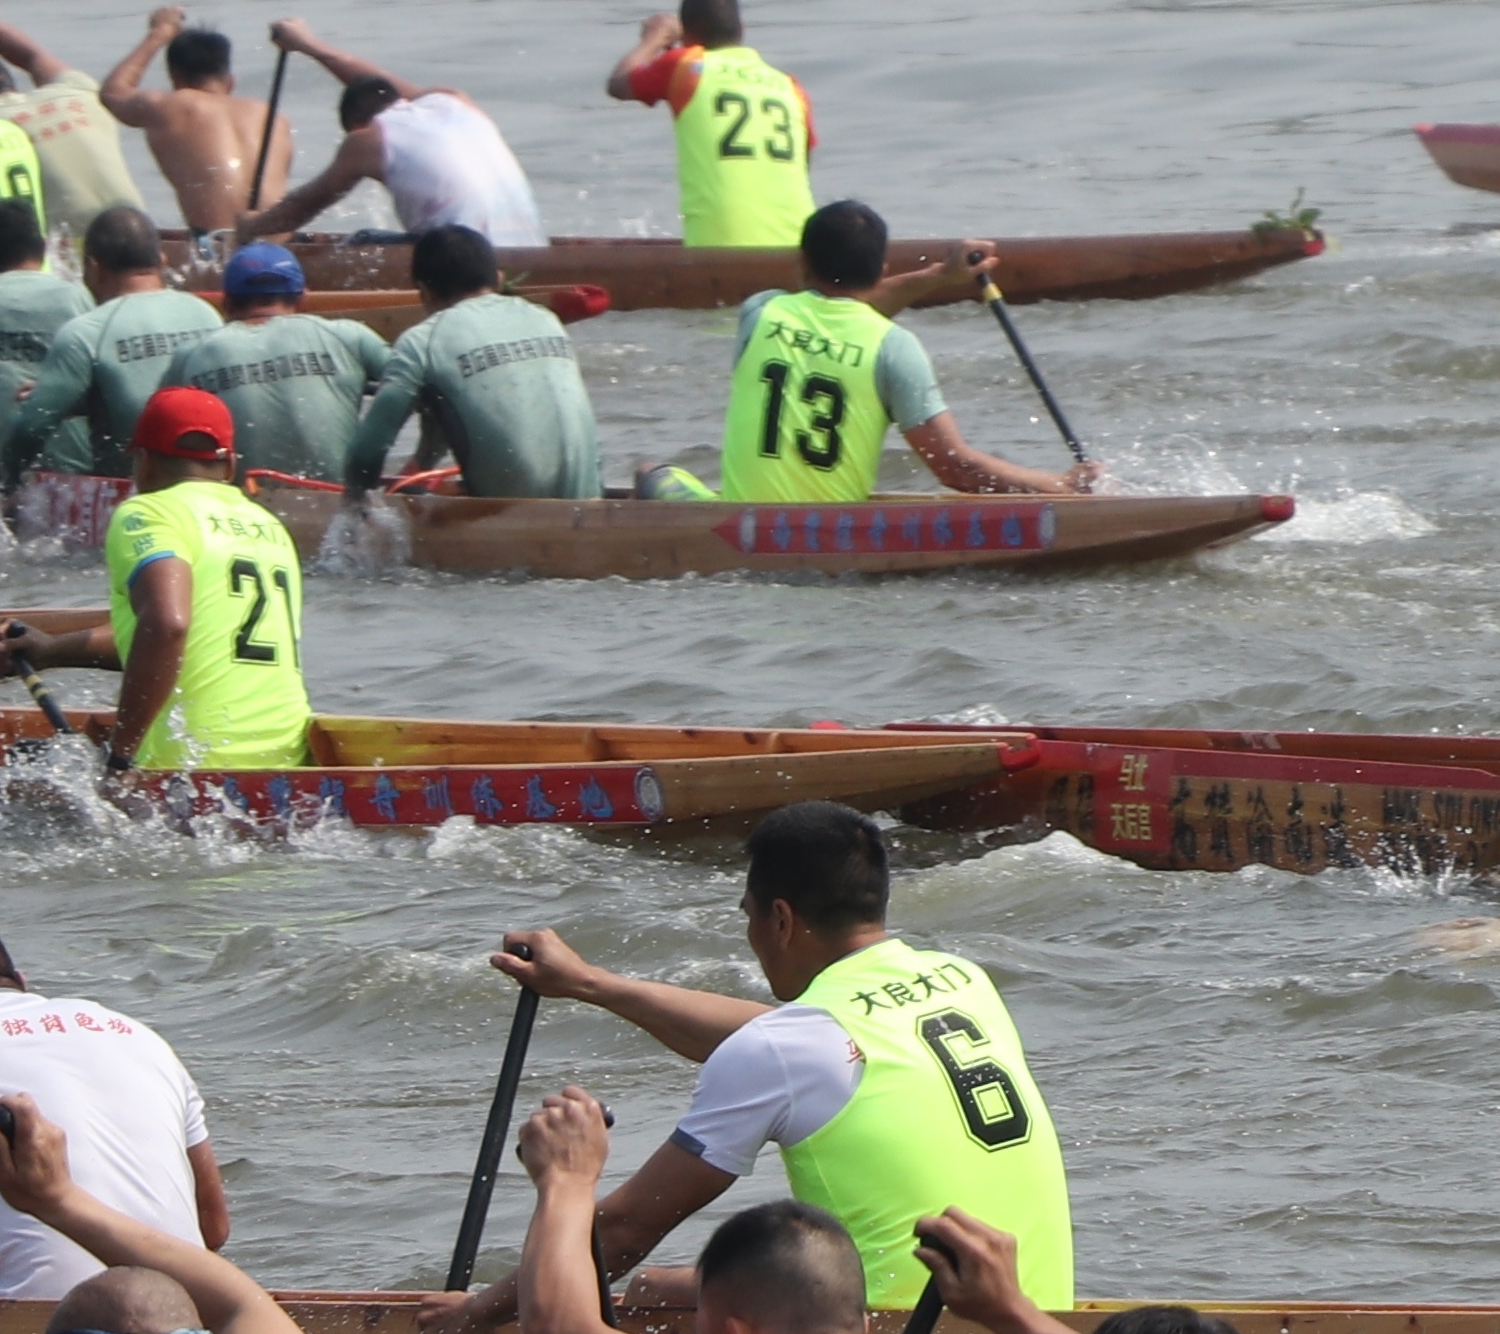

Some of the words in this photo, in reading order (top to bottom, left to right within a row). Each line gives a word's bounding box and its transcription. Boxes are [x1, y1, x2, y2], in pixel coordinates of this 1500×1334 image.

[714, 86, 795, 163] 23
[767, 319, 863, 368] 大良大门
[758, 357, 848, 473] 13
[208, 513, 290, 547] 大良大门
[226, 553, 302, 673] 21
[1110, 803, 1153, 842] 天后宫
[849, 963, 974, 1017] 大良大门
[915, 1006, 1034, 1154] 6
